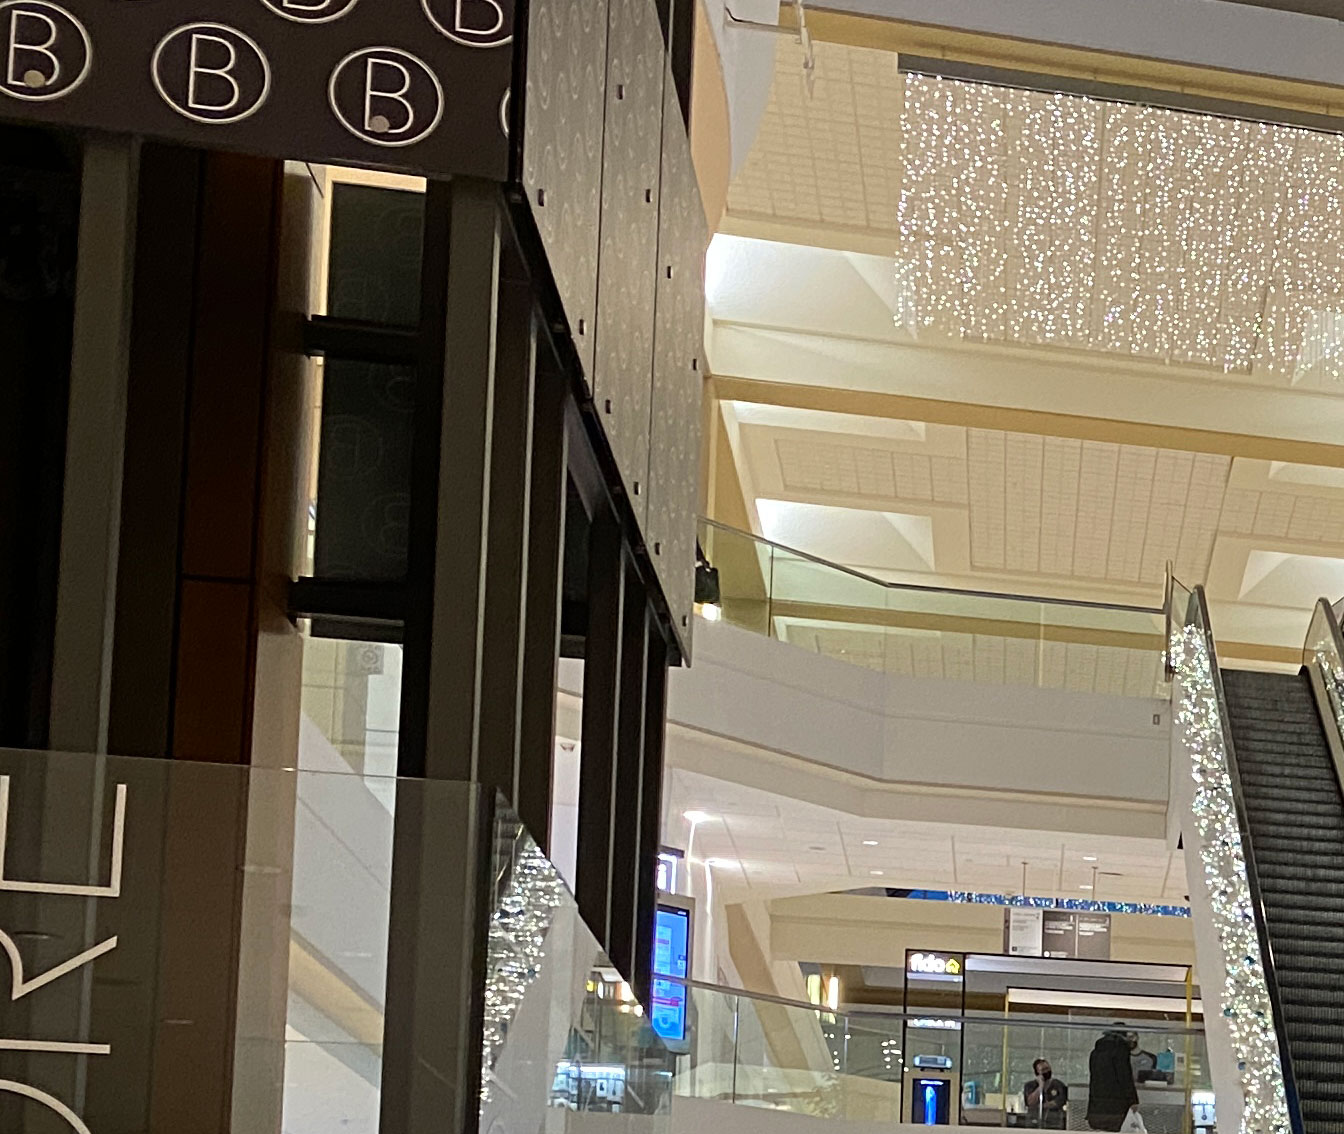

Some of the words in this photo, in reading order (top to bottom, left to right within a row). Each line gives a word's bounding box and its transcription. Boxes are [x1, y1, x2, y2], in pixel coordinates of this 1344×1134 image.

[7, 7, 60, 87] B
[188, 33, 241, 112] B
[364, 56, 415, 133] B
[910, 953, 945, 973] fido
